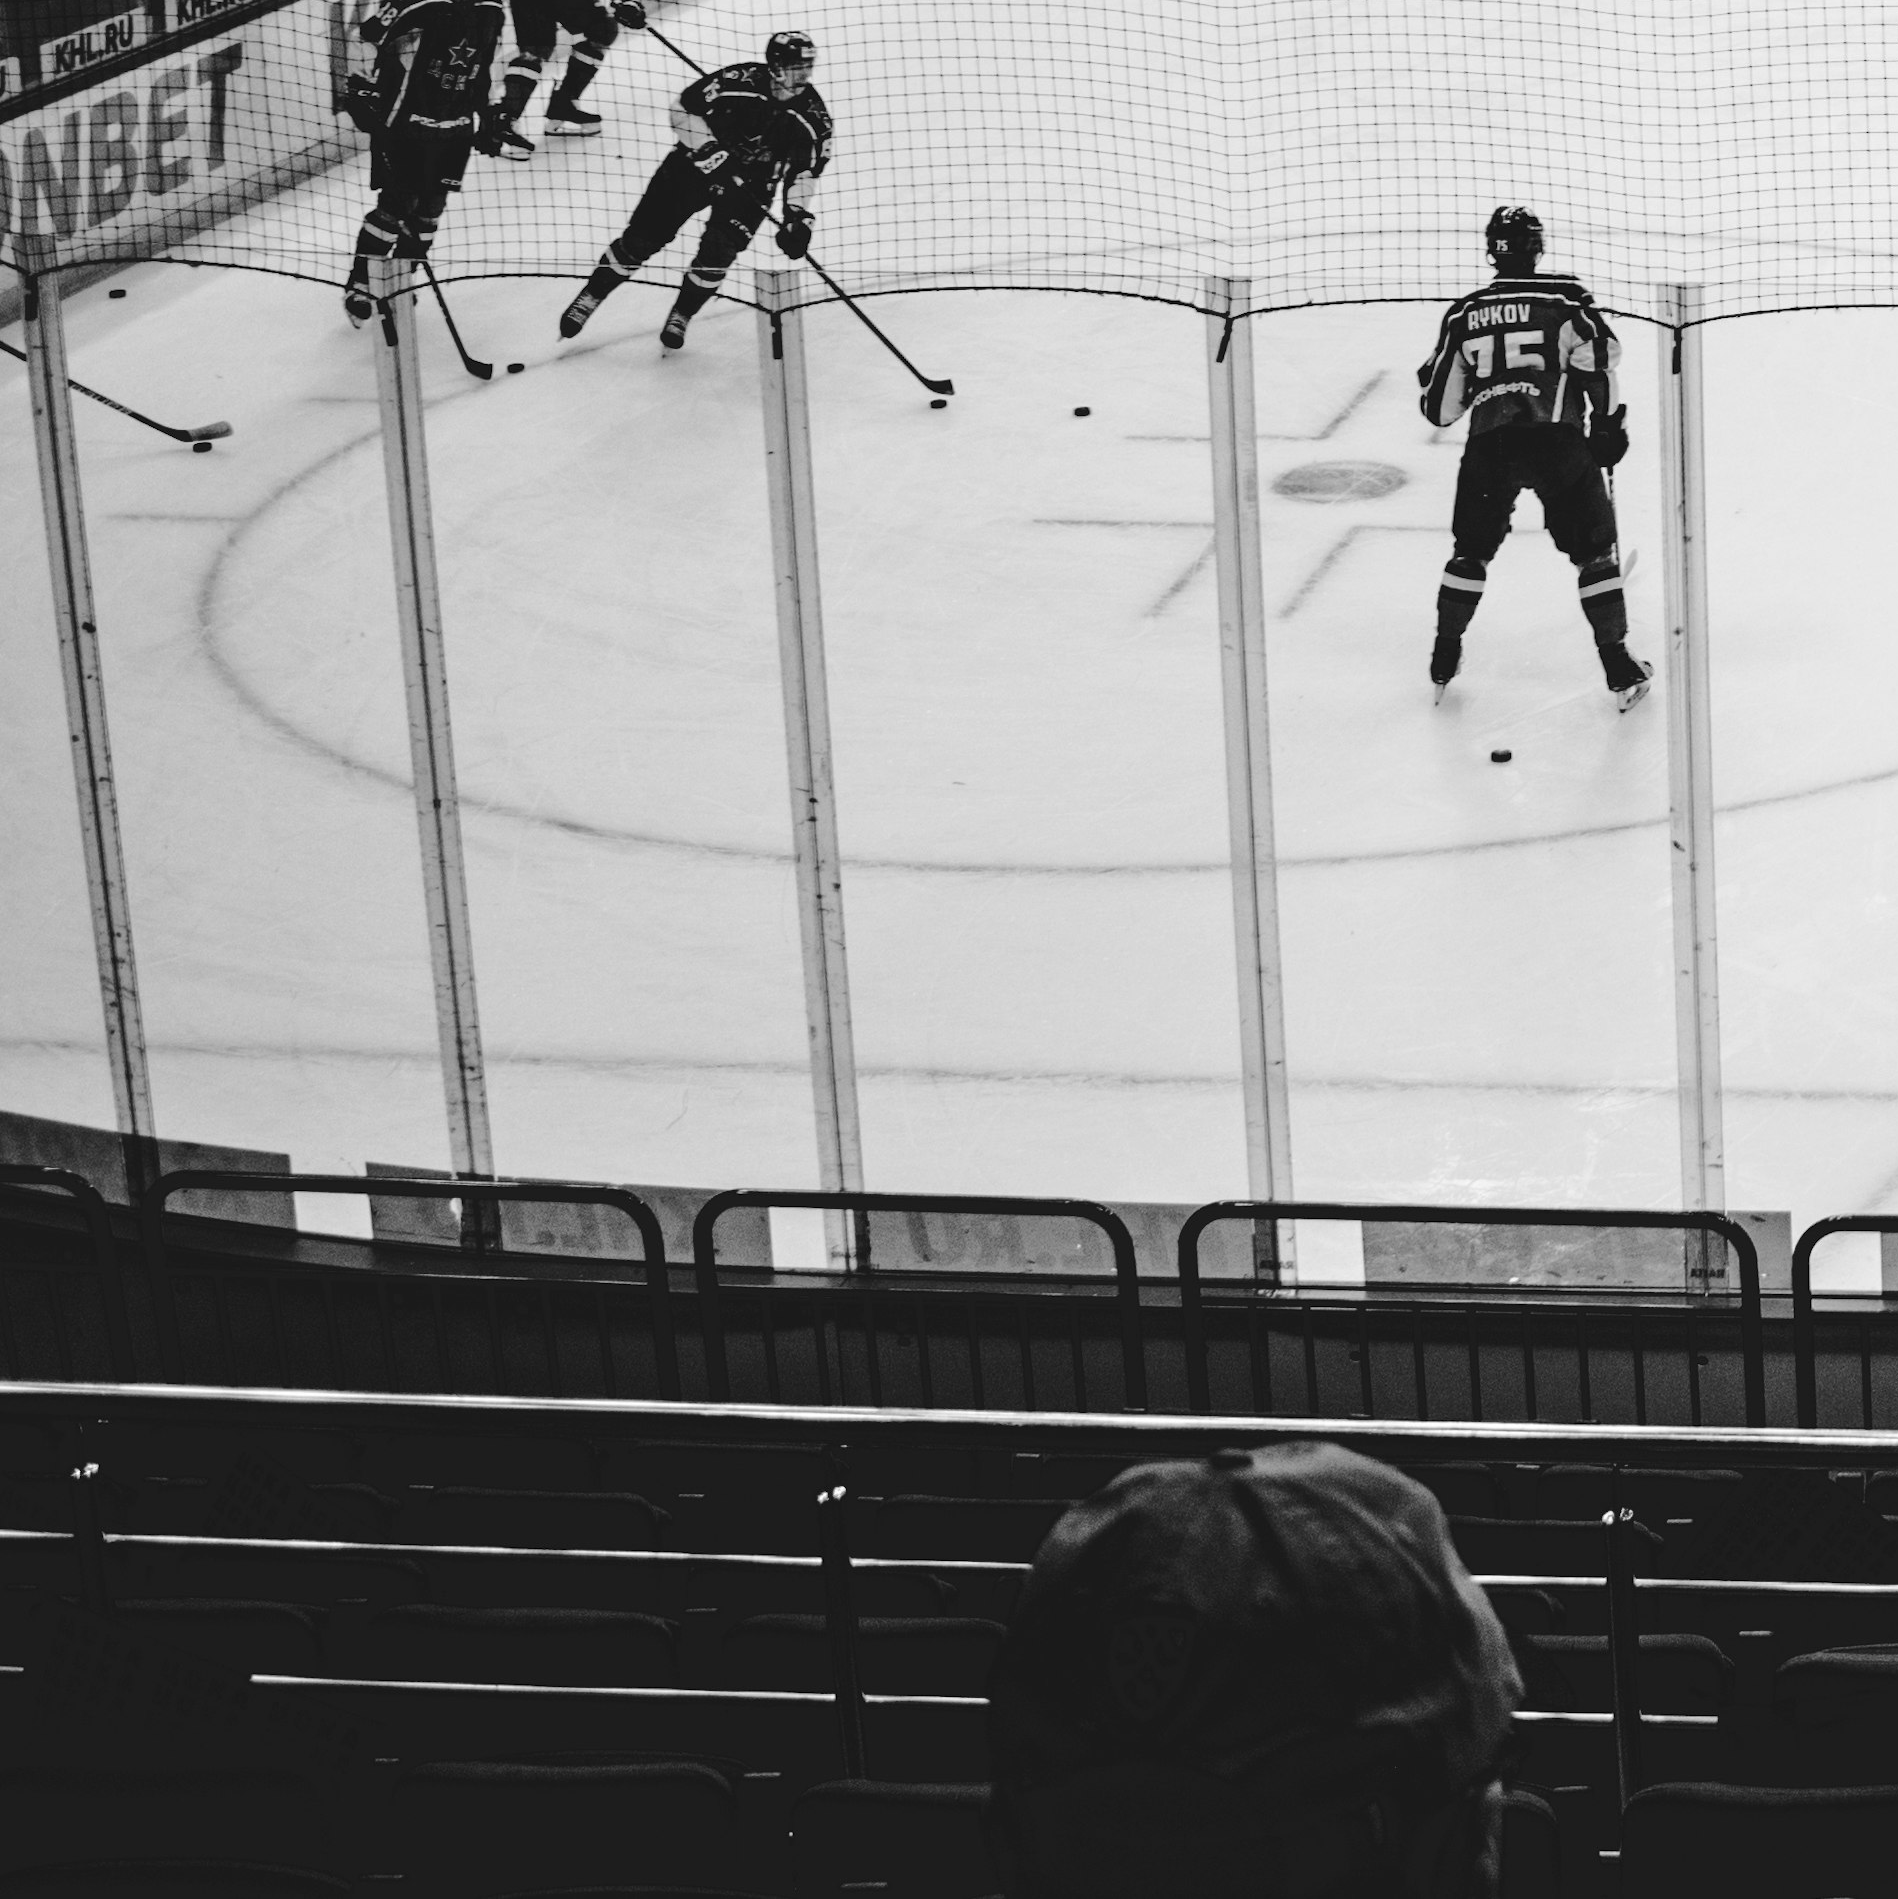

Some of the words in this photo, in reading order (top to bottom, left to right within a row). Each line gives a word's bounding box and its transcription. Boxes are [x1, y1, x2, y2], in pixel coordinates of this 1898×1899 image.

[53, 14, 134, 76] KHL.RU
[1495, 239, 1509, 252] 75
[1467, 303, 1531, 331] RYKOV
[1462, 330, 1546, 379] 75
[1471, 382, 1541, 406] ОСНЕФТЬ
